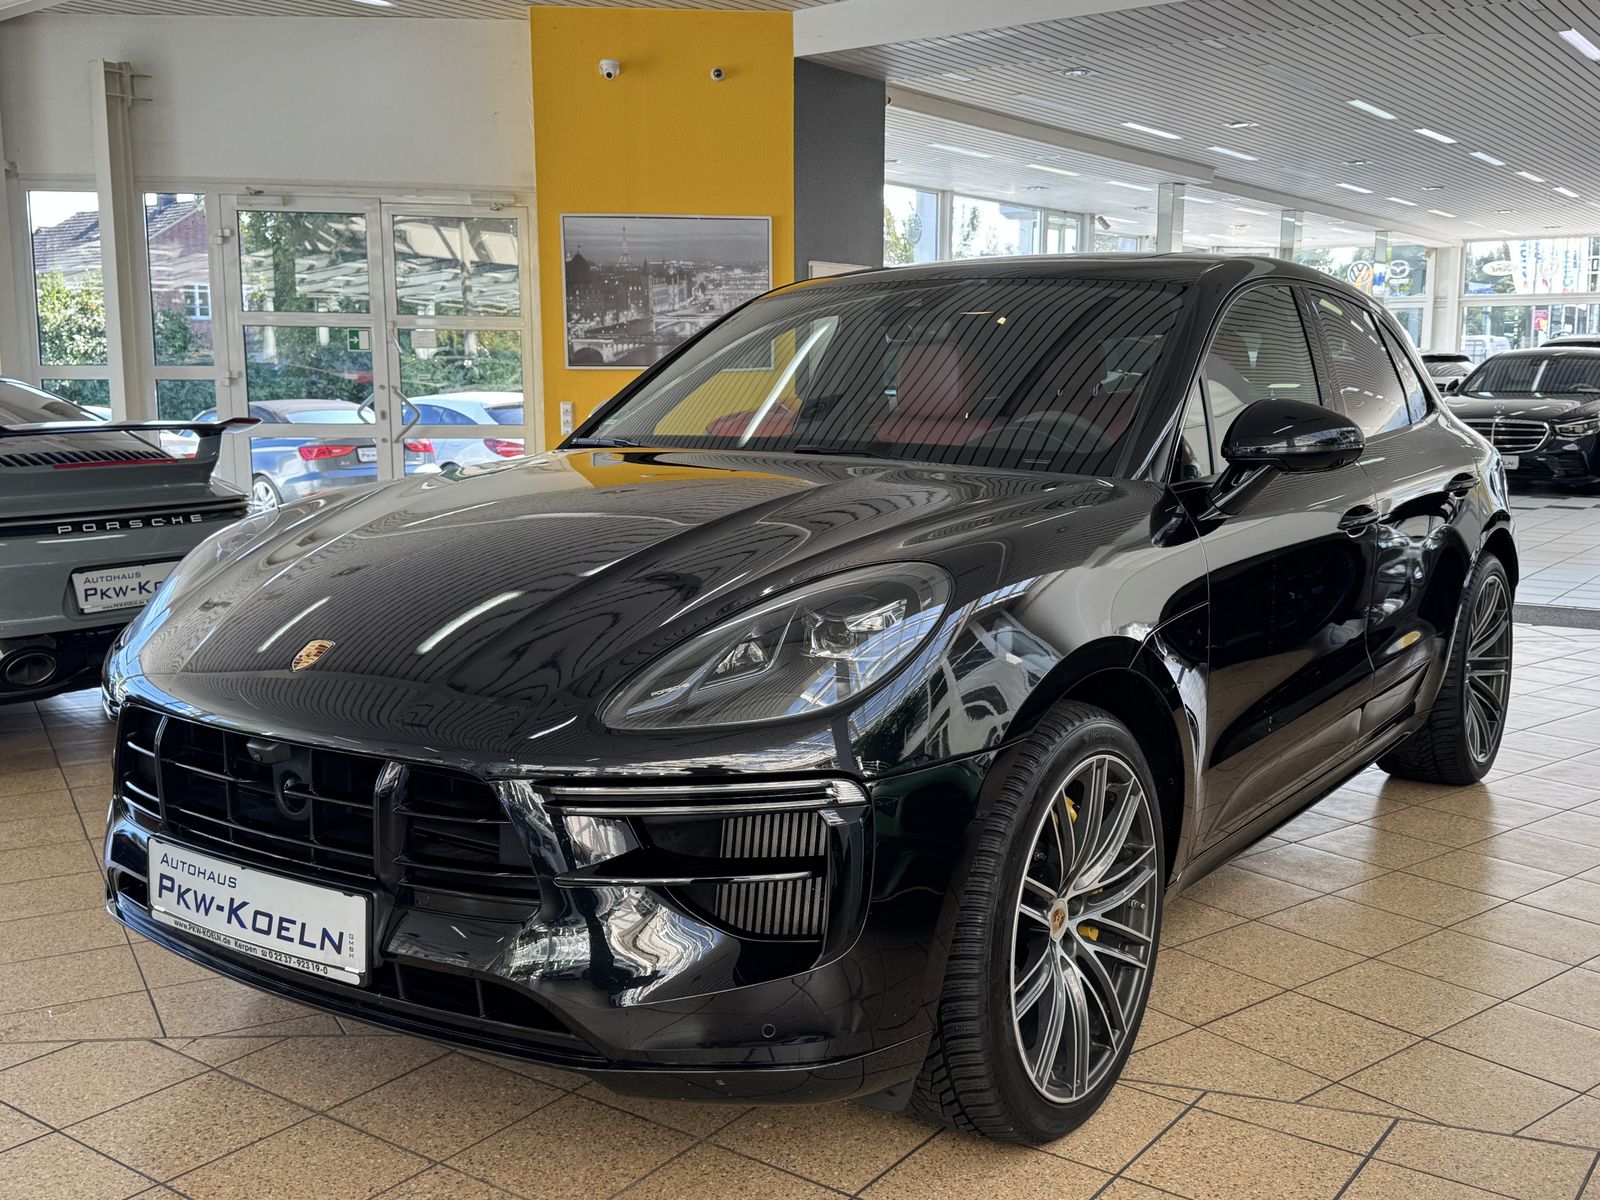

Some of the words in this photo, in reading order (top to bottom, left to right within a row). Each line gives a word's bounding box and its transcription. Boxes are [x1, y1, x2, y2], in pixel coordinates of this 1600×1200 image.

[57, 514, 203, 535] PORSCHE
[83, 571, 142, 585] AUTOHAUS
[160, 853, 238, 889] AUTOHAUS
[158, 873, 344, 955] PKW-KOELN
[234, 940, 258, 955] Kerpen
